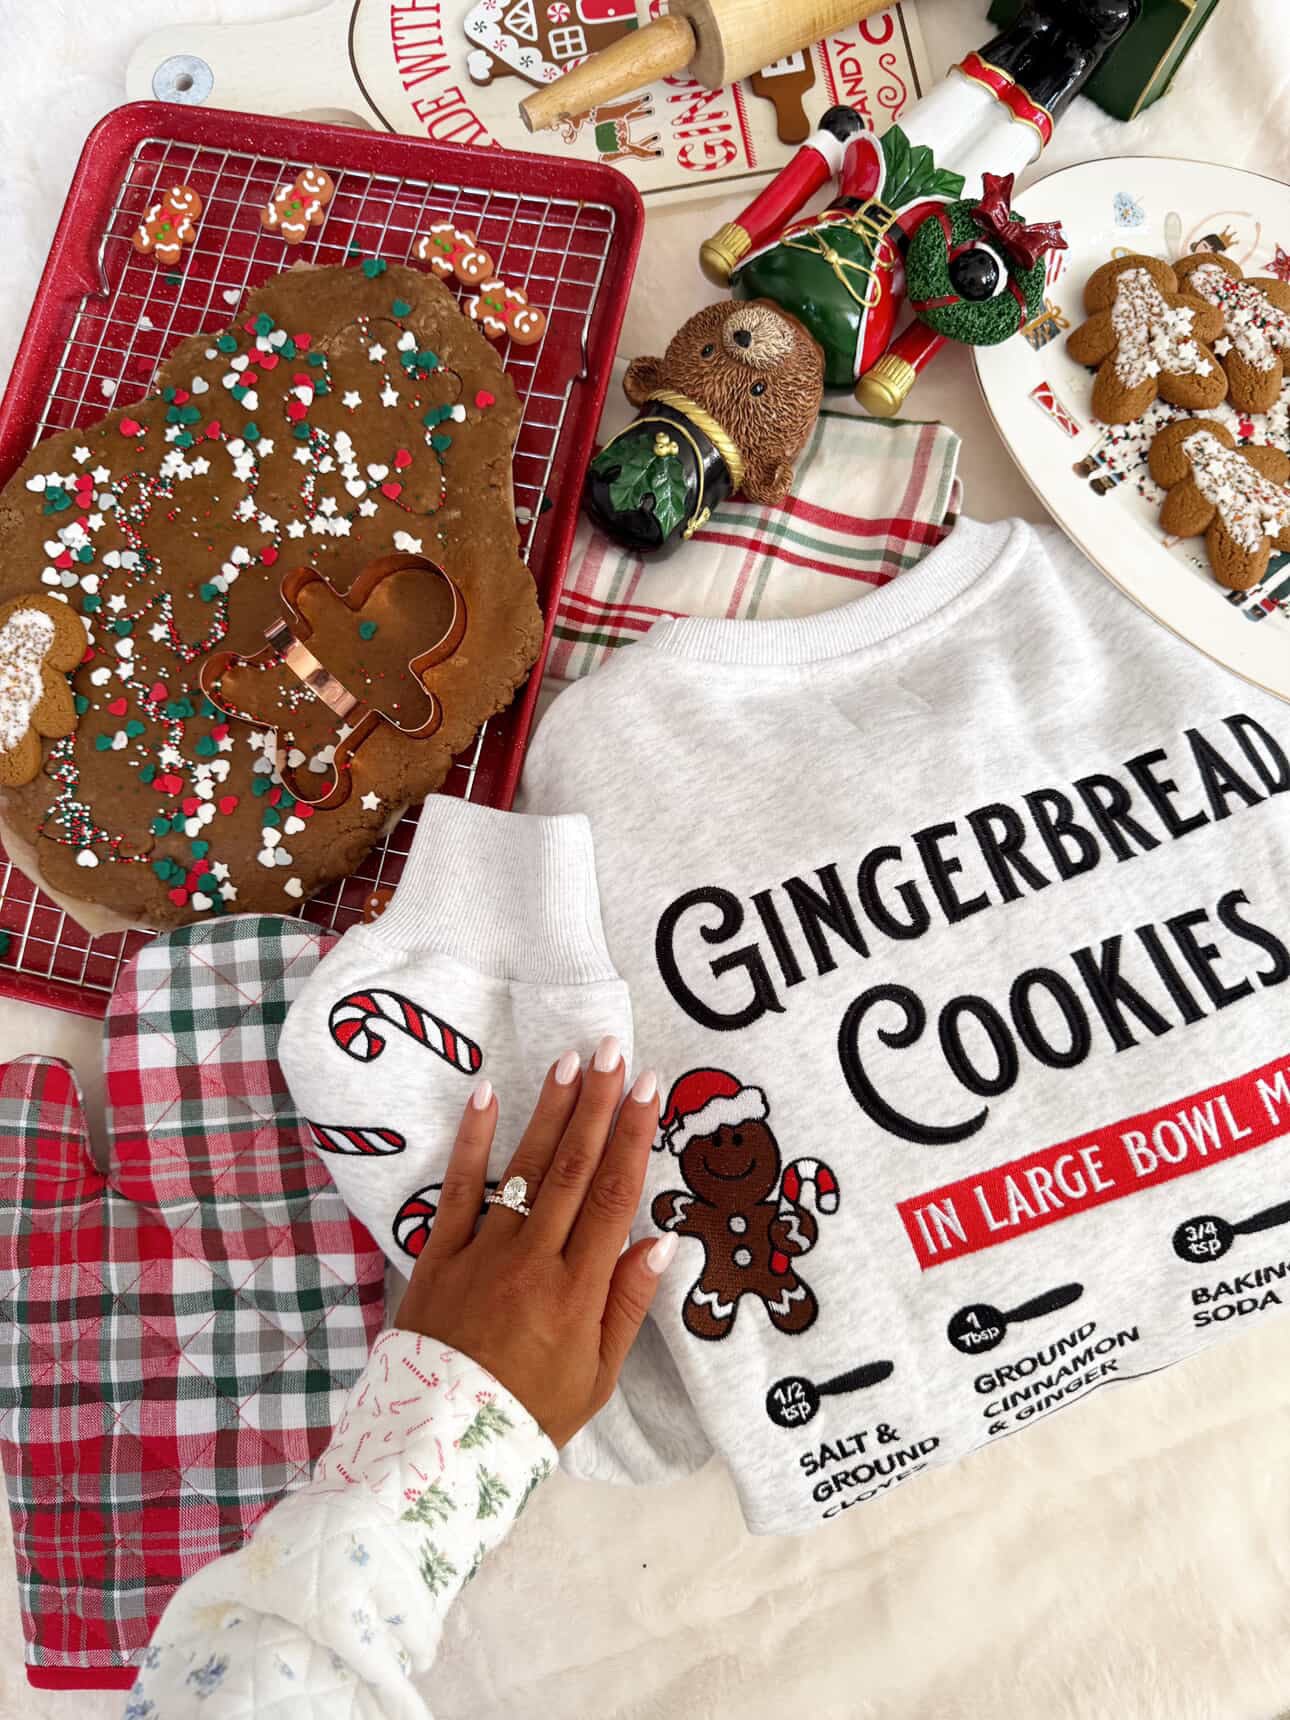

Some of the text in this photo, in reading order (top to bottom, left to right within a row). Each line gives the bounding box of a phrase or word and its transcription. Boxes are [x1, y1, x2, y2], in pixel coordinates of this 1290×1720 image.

[833, 39, 874, 132] ANDY
[655, 713, 1290, 1031] GINGERBREAD
[837, 889, 1290, 1145] COOKIES
[913, 1197, 967, 1255] IN
[974, 1145, 1114, 1231] LARGE
[1121, 1095, 1252, 1178] BOWL
[1184, 1221, 1217, 1240] 3/4
[1188, 1238, 1221, 1255] tsp
[1191, 1262, 1290, 1305] BAKIN
[1192, 1290, 1282, 1327] SODA
[958, 1327, 999, 1347] Tbsp
[966, 1312, 981, 1329] 1
[974, 1321, 1097, 1394] GROUND
[983, 1326, 1140, 1418] CINNAMON
[774, 1381, 805, 1405] 1/2
[780, 1400, 812, 1421] tsp
[987, 1359, 1119, 1435] & GINGER
[800, 1423, 900, 1477] SALT &
[812, 1437, 940, 1502] GROUND
